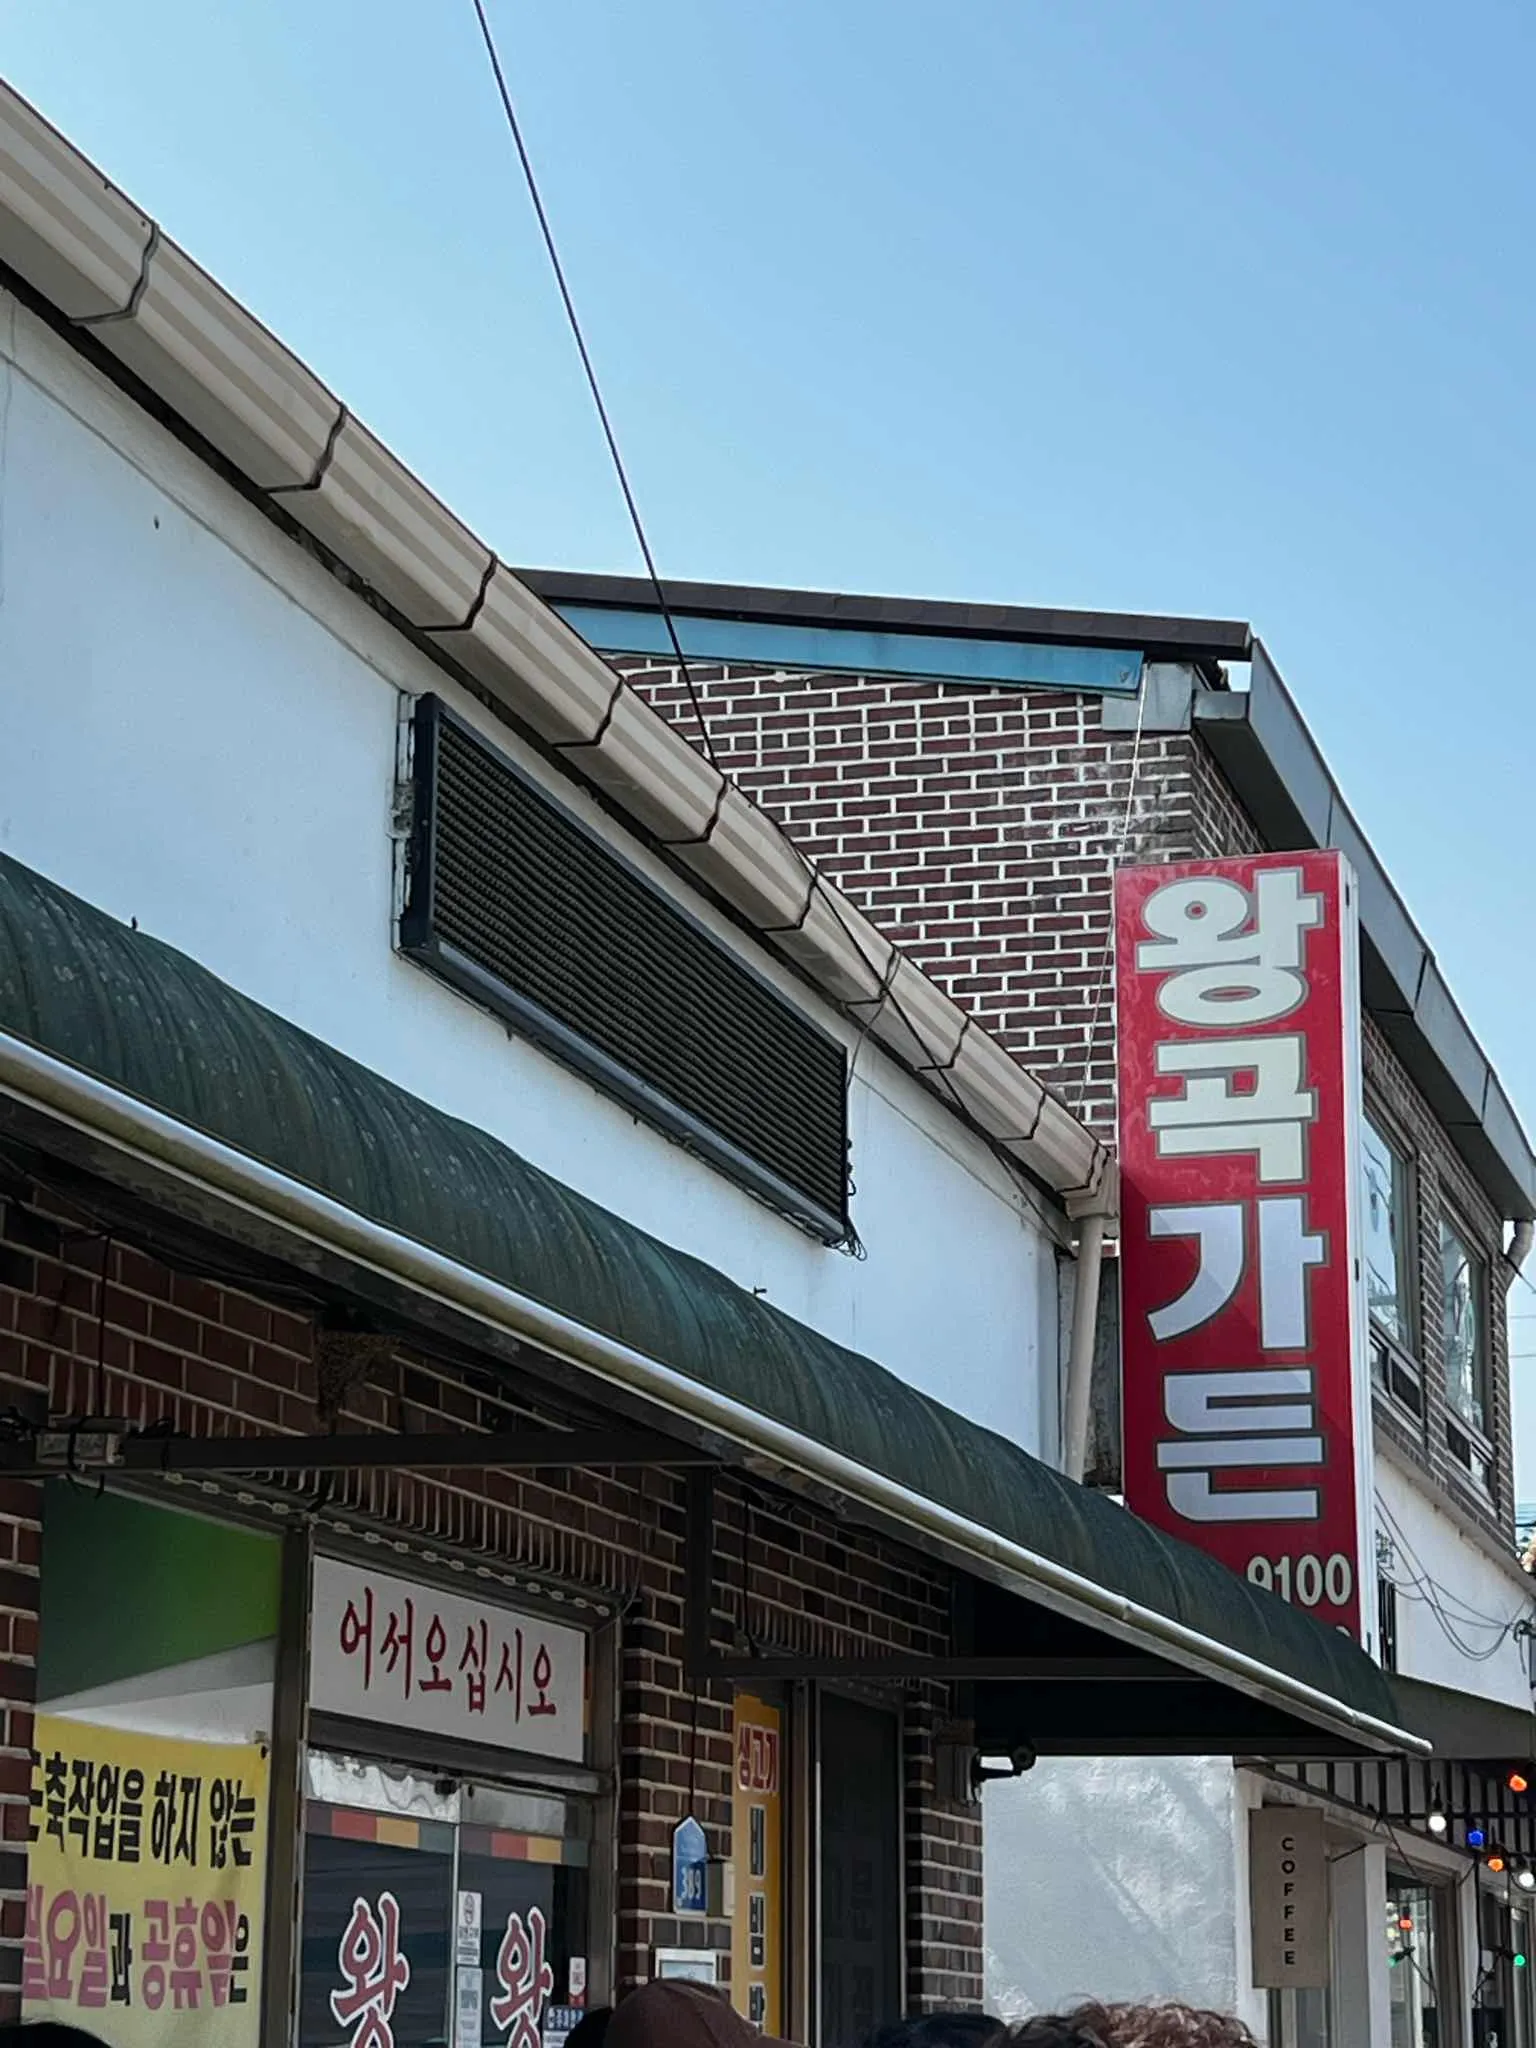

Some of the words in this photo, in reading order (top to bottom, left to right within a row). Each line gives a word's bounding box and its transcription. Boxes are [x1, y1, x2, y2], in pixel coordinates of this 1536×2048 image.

[1136, 867, 1328, 1522] 왕곡가든
[340, 1586, 556, 1724] 어서오십시오
[152, 1770, 202, 1867] 하지
[210, 1778, 256, 1869] 않는
[142, 1896, 249, 2010] 공휴일은
[1281, 1837, 1296, 1965] COFFEE
